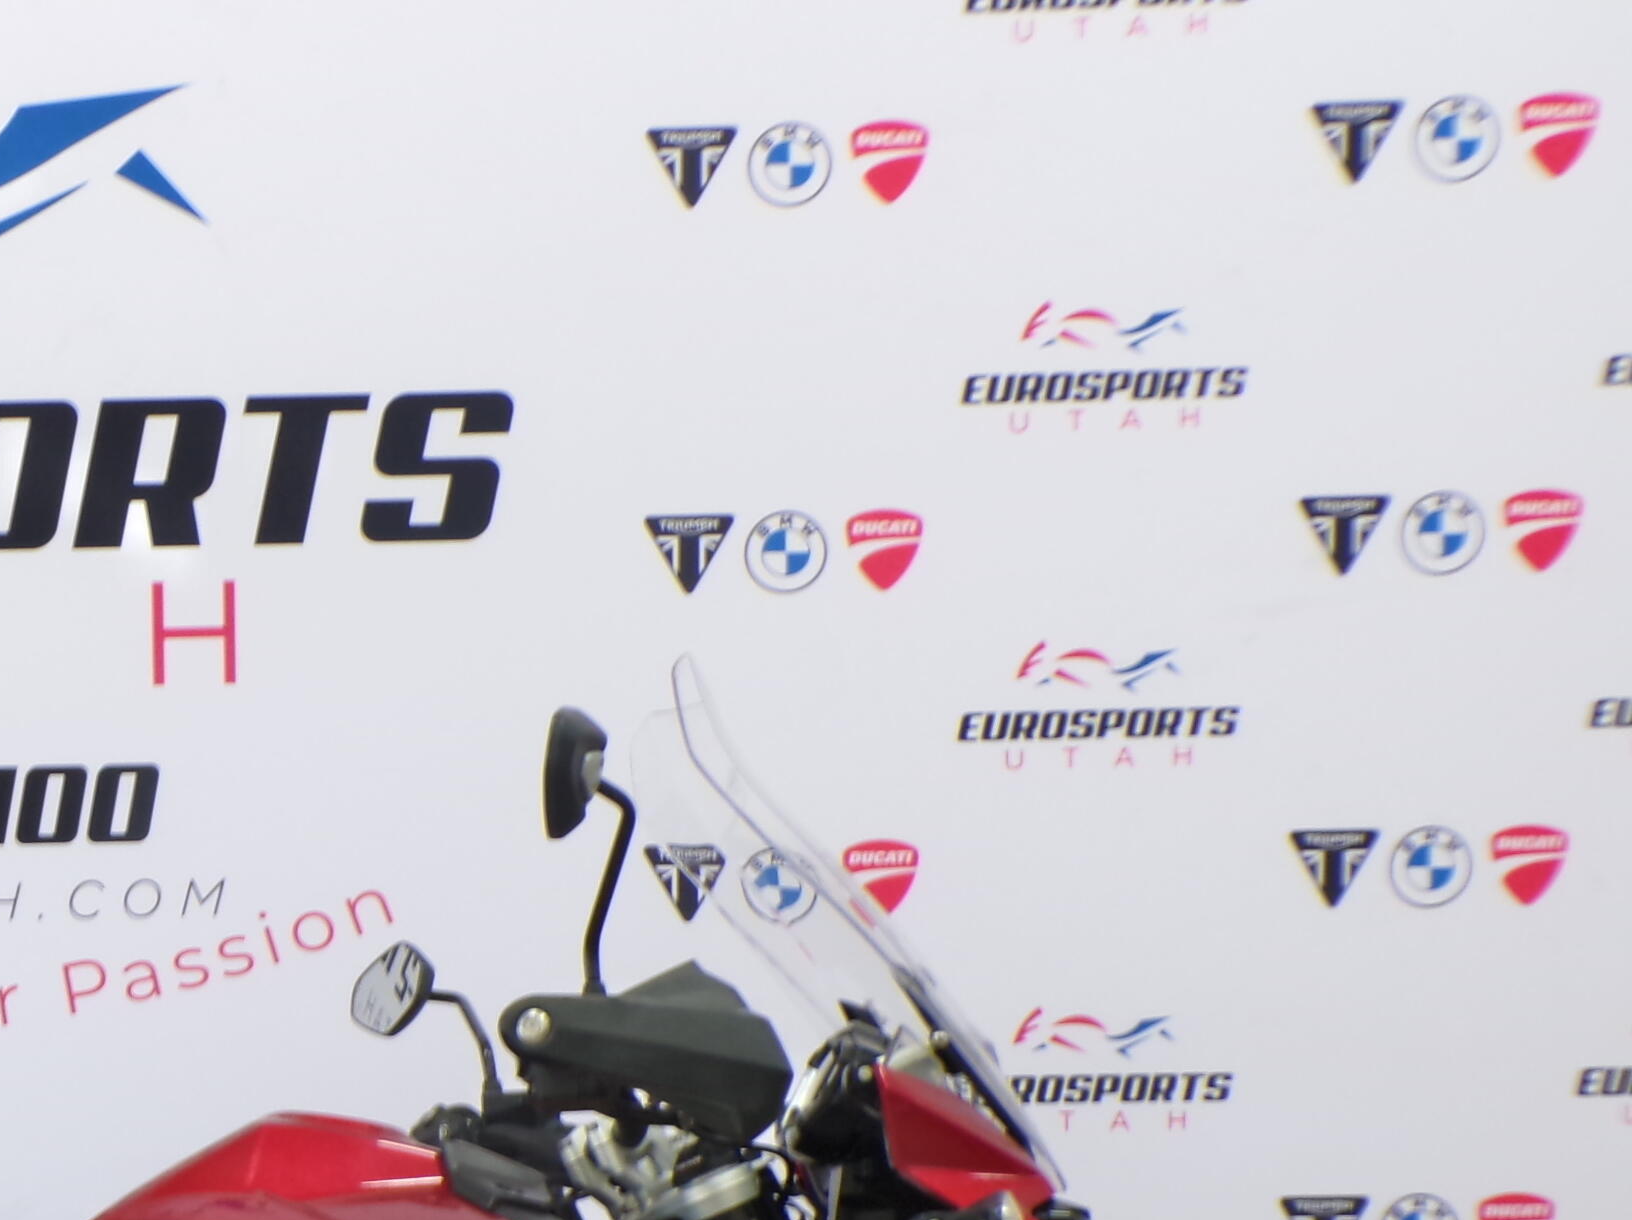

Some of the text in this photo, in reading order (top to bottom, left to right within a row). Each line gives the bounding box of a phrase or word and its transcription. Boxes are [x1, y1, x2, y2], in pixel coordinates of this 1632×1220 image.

[855, 129, 924, 147] DUCATI
[960, 366, 1249, 404] EUROSPORTS
[1008, 407, 1204, 435] UTAH
[851, 518, 918, 535] DUCATI
[956, 707, 1240, 742] EUROSPORTS
[1003, 745, 1197, 772] UTAH
[848, 848, 915, 865] DUCATI
[60, 888, 396, 1016] Passion
[1010, 1072, 1234, 1103] ROSPORTS
